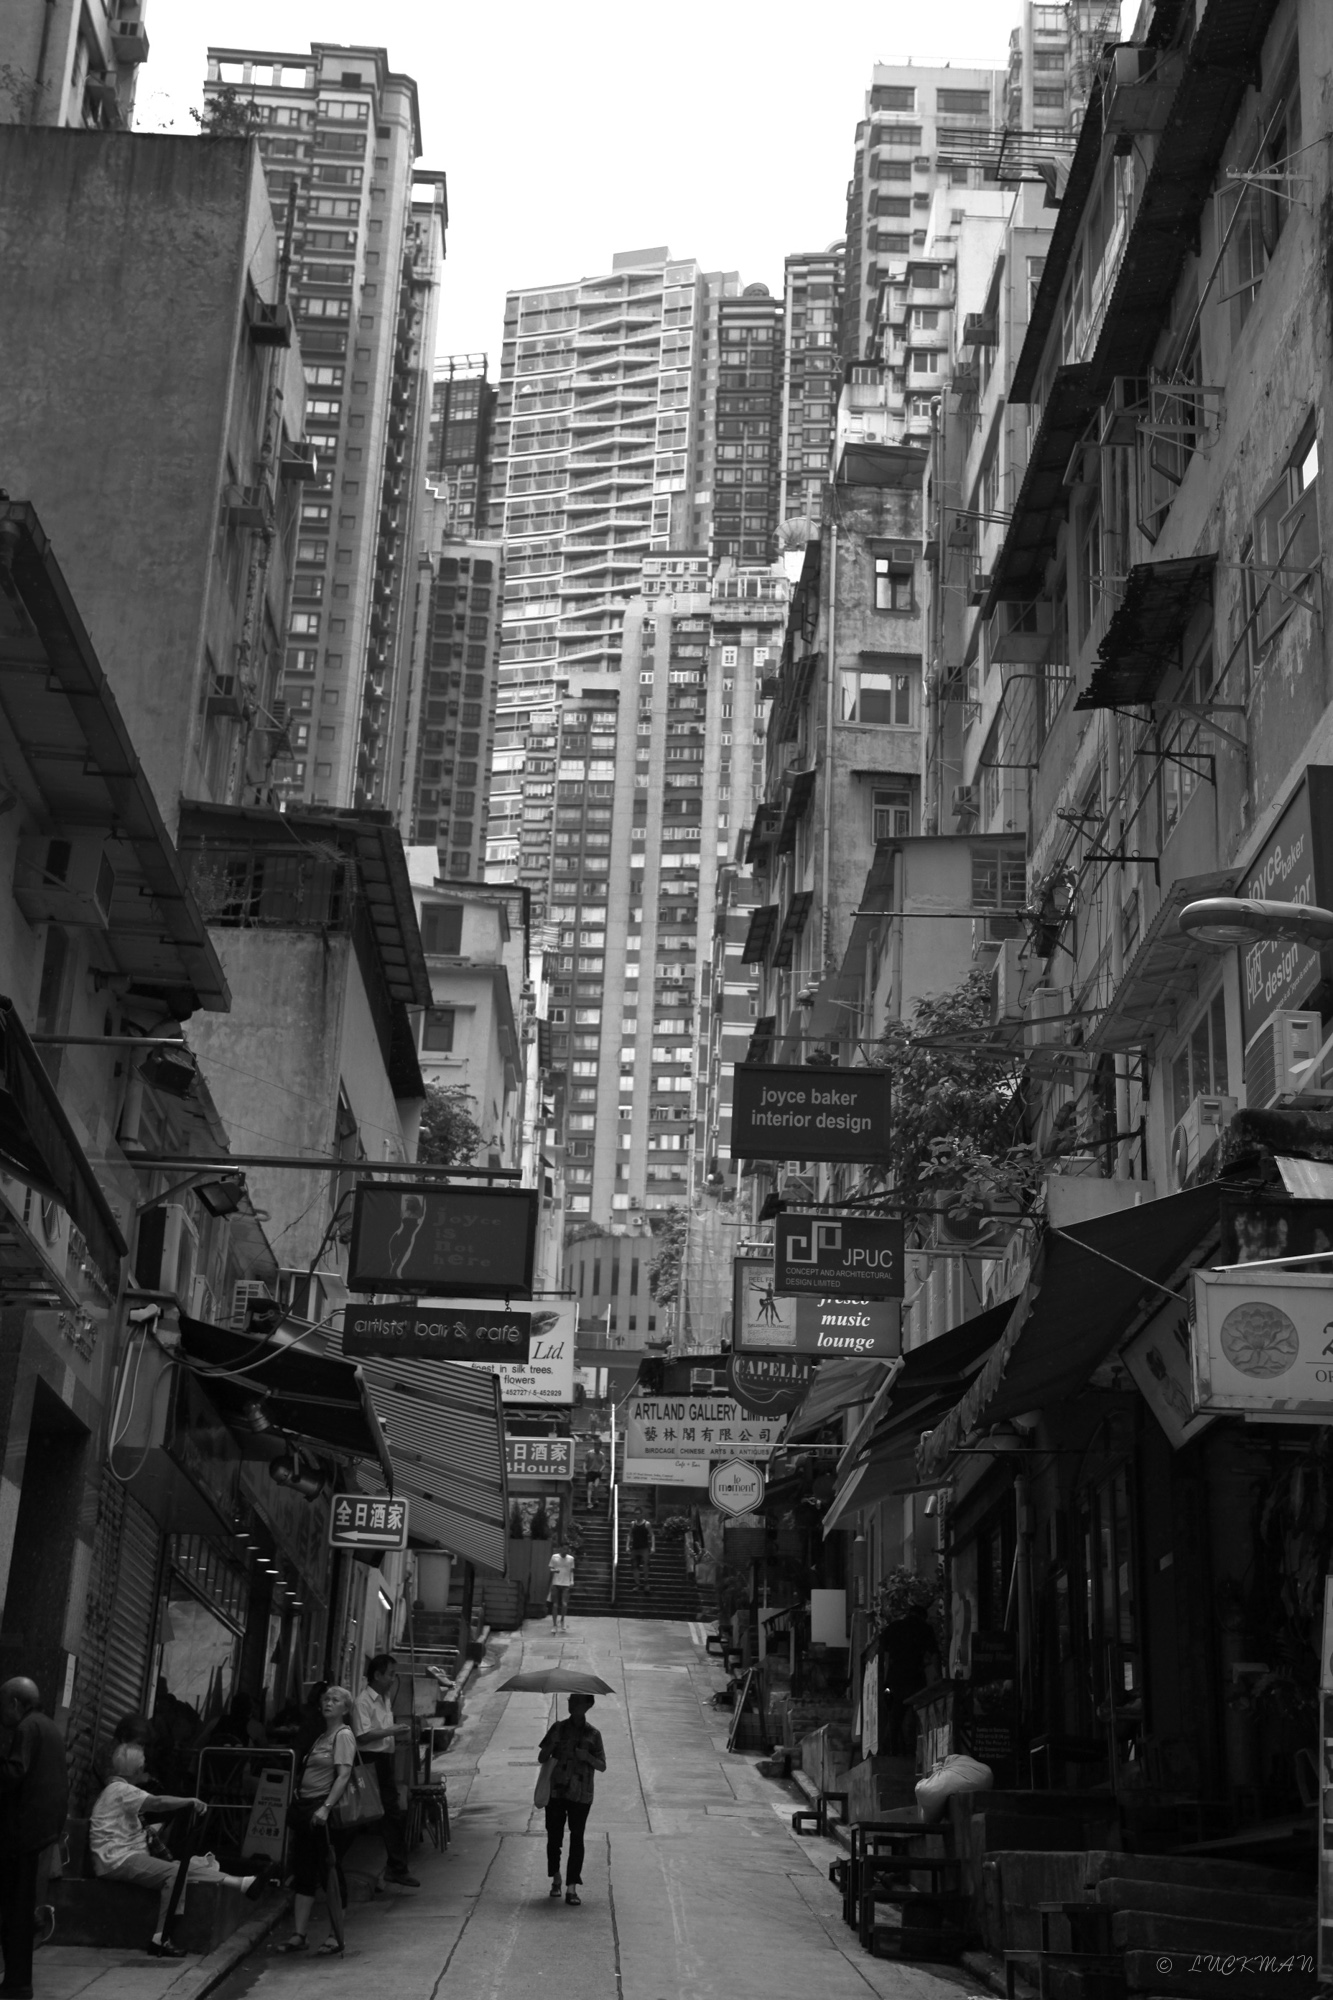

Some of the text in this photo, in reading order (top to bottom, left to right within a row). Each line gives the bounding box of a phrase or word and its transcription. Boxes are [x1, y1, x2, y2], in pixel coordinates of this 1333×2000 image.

[1281, 833, 1305, 882] baker
[1265, 942, 1298, 1002] design
[760, 1086, 858, 1106] joyce baker
[751, 1110, 872, 1133] interior design
[432, 1207, 502, 1227] joyce
[435, 1228, 457, 1239] is
[434, 1240, 475, 1253] not
[432, 1253, 491, 1267] here
[842, 1248, 893, 1268] JPUC
[785, 1267, 893, 1280] CONCEPT AND ARCHITECTURAL
[785, 1278, 840, 1288] DESIGN LIMITED
[821, 1312, 871, 1327] music
[413, 1320, 449, 1338] bar
[452, 1321, 471, 1340] &
[475, 1323, 521, 1343] café
[531, 1341, 565, 1360] Ltd.
[817, 1332, 875, 1353] lounge
[500, 1365, 507, 1374] in
[511, 1365, 525, 1374] silk
[735, 1359, 808, 1379] CAPELLI
[503, 1375, 536, 1385] flowers
[634, 1403, 685, 1421] ARTLAND
[689, 1403, 738, 1421] GALLERY
[644, 1447, 675, 1455] BIRDCAGE
[738, 1448, 770, 1456] ANTIQUES
[336, 1500, 403, 1530] 全日酒家
